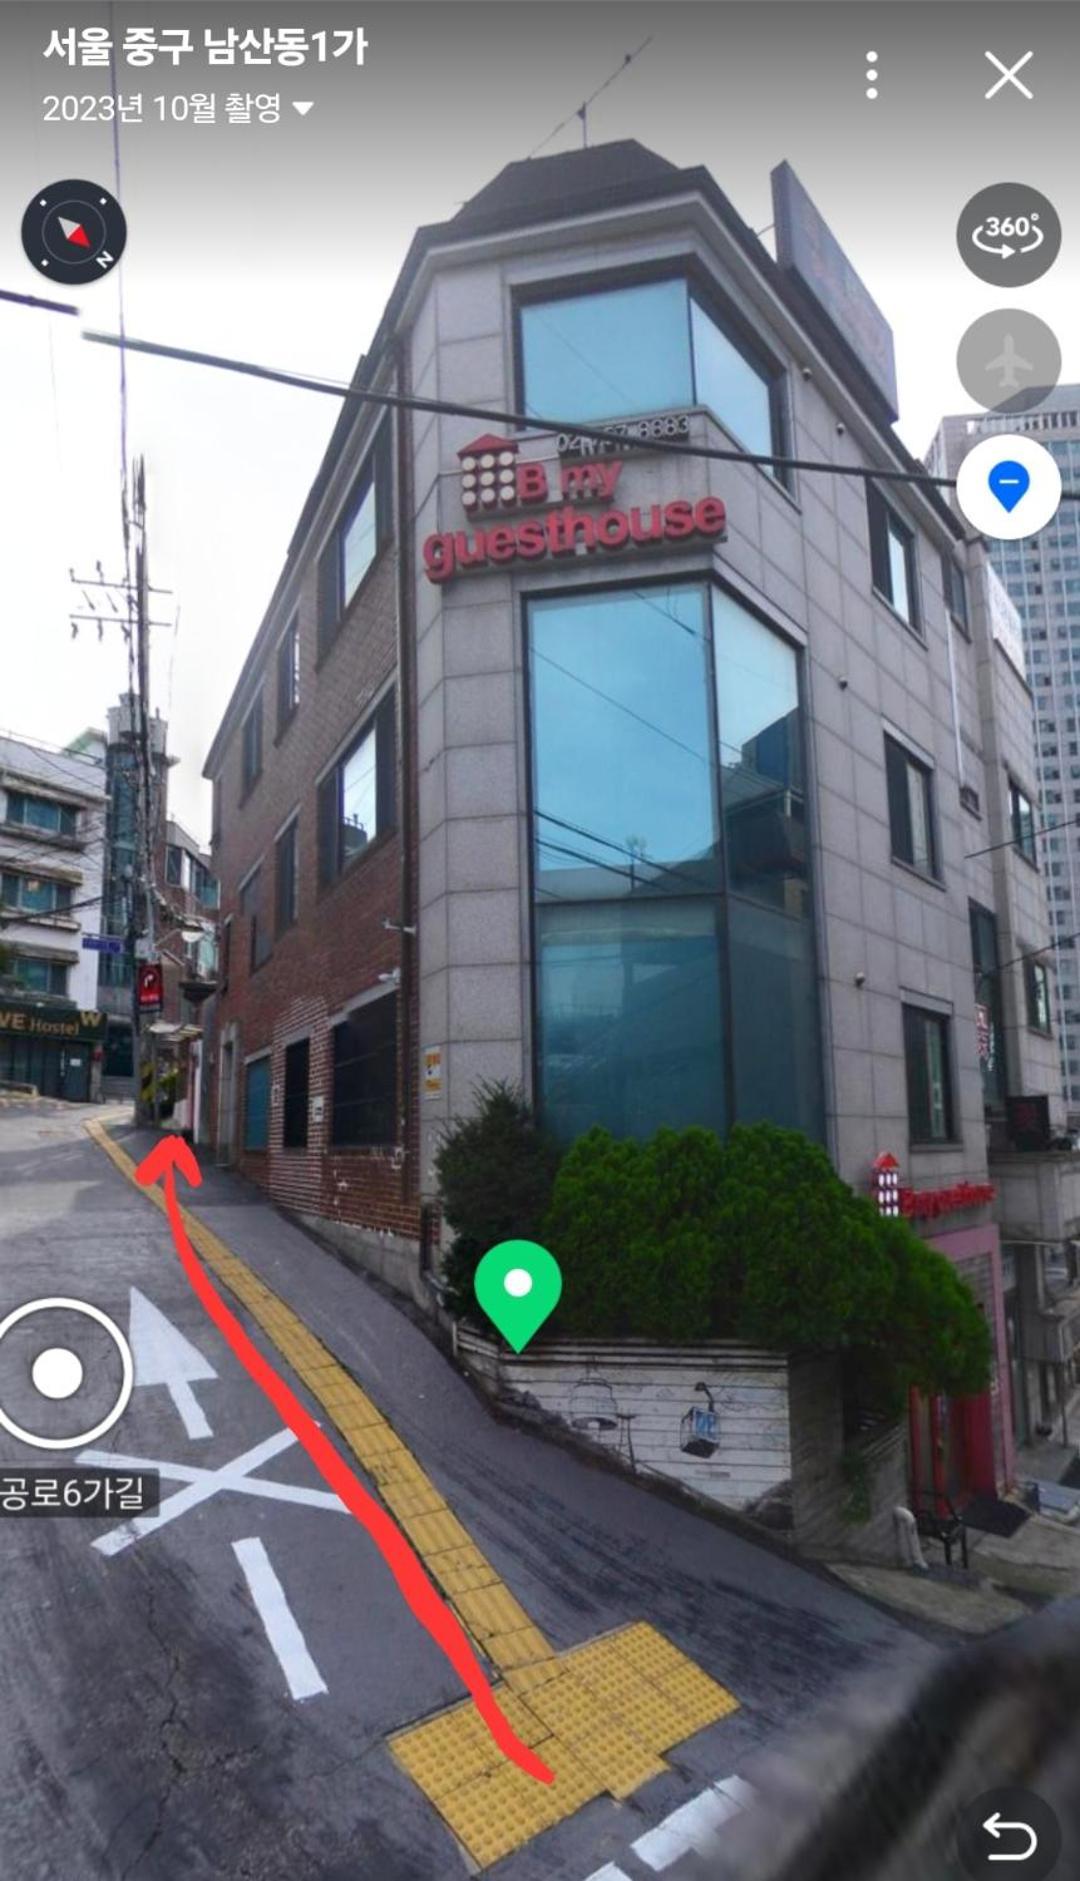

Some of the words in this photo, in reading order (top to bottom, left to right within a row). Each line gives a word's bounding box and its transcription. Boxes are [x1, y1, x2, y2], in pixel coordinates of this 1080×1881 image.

[516, 462, 548, 503] B
[560, 459, 623, 500] my
[423, 496, 727, 583] guesthouse
